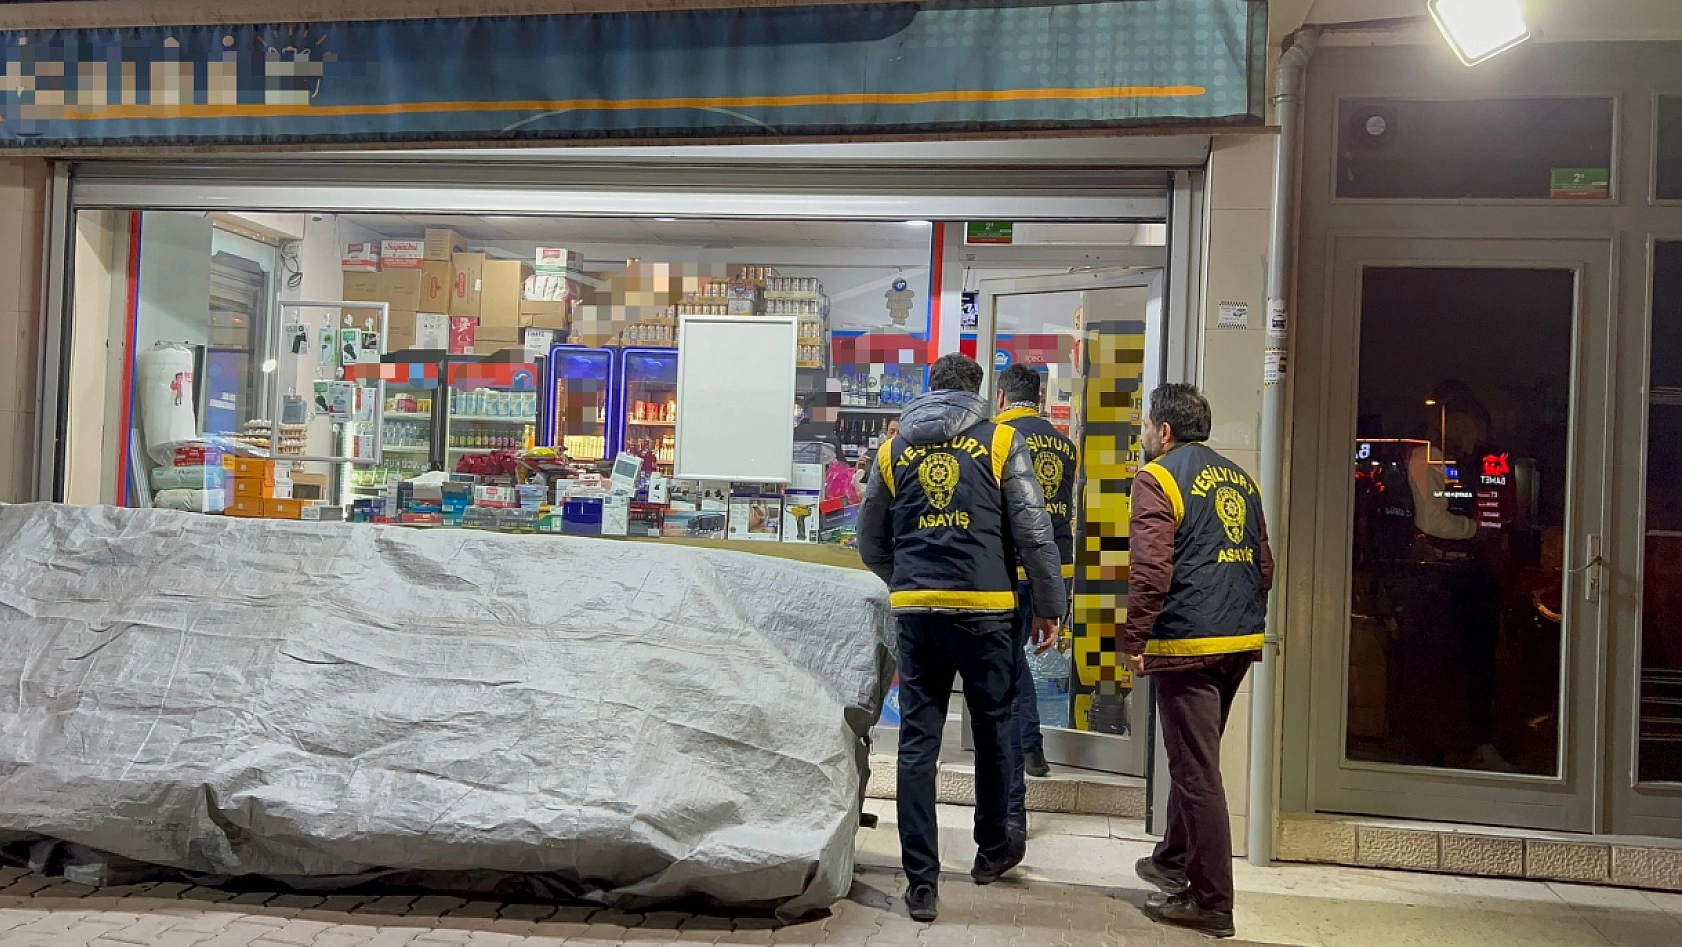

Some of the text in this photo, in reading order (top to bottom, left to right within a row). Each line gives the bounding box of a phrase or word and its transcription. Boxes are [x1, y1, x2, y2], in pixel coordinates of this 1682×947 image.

[896, 435, 989, 466] YEŞLURT
[1025, 432, 1075, 461] ŞİLYURT
[1191, 464, 1255, 498] YEŞİLYURT
[918, 510, 970, 530] ASAYİŞ
[1045, 500, 1067, 518] AYİŞ
[1218, 544, 1254, 565] ASAYİŞ
